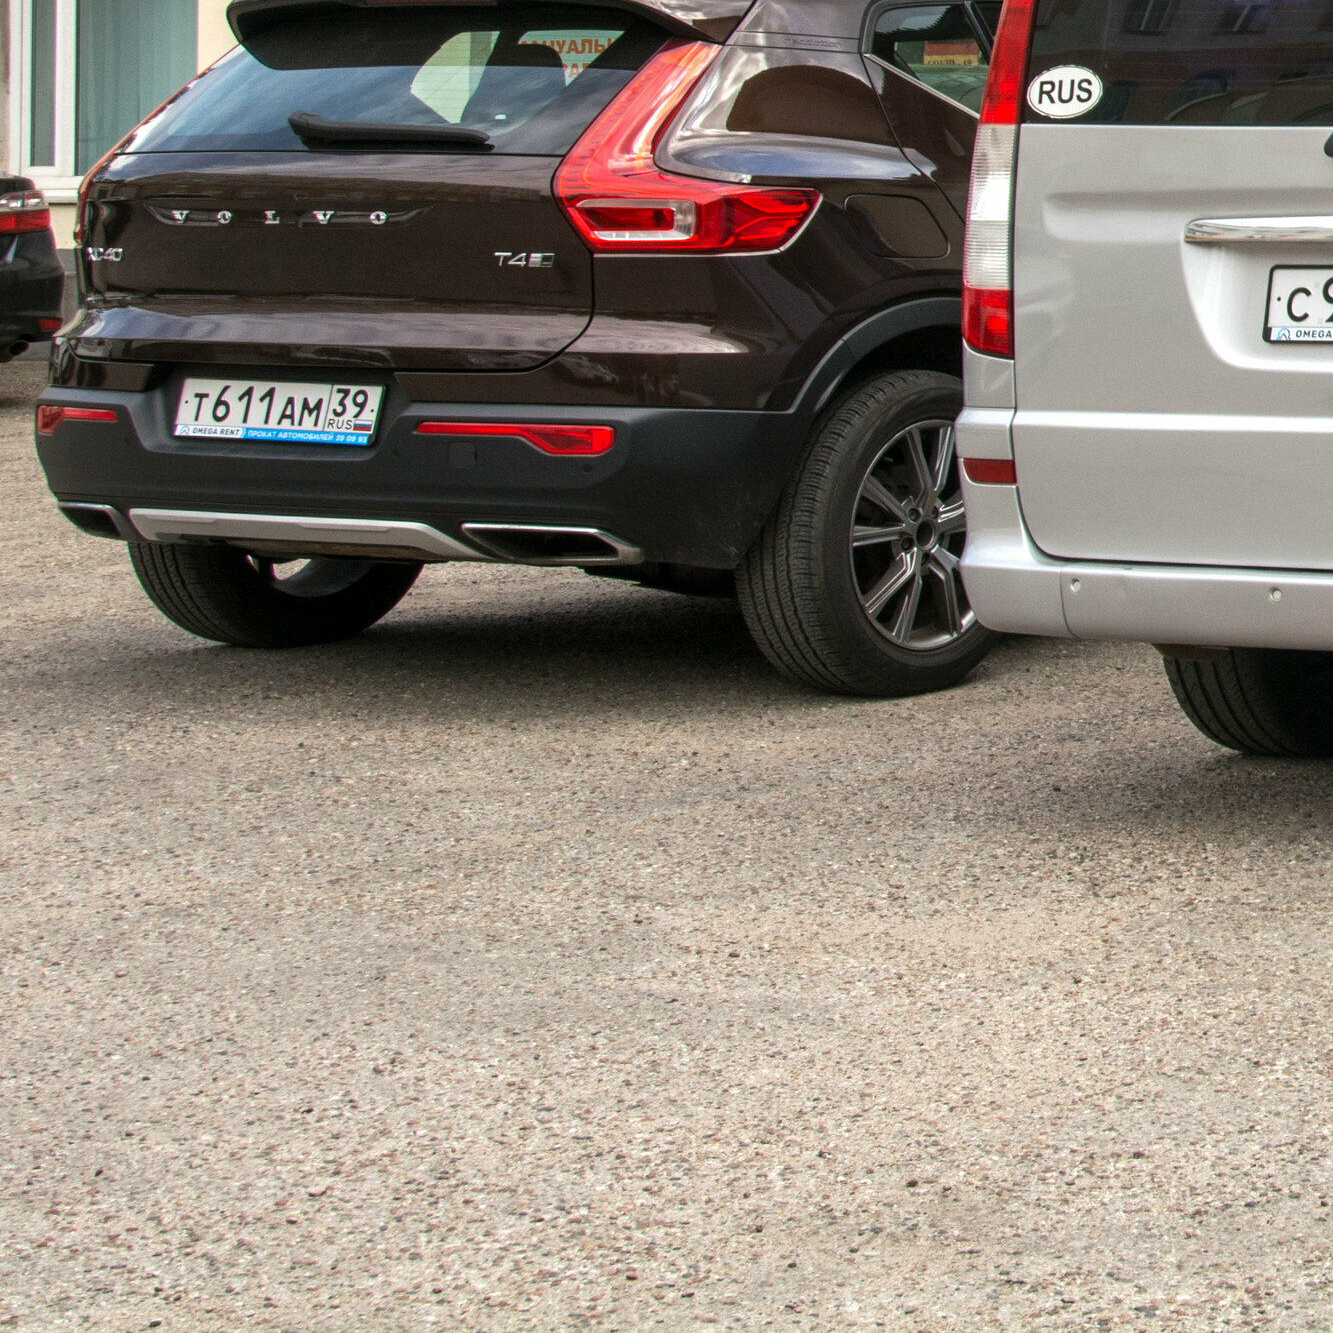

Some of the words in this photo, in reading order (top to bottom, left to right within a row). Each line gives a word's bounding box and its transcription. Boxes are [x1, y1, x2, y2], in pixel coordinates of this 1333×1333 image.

[1038, 78, 1092, 104] RUS
[172, 210, 387, 224] VOLVO
[1295, 330, 1332, 339] OMEGA
[194, 385, 323, 427] Т611АМ
[332, 388, 368, 418] 39
[327, 419, 353, 430] RUS
[192, 427, 218, 435] OMEGA
[219, 428, 241, 436] RENT
[248, 430, 276, 438] ПРОКАТ
[278, 431, 334, 441] АВТОМОБИЛЕЙ
